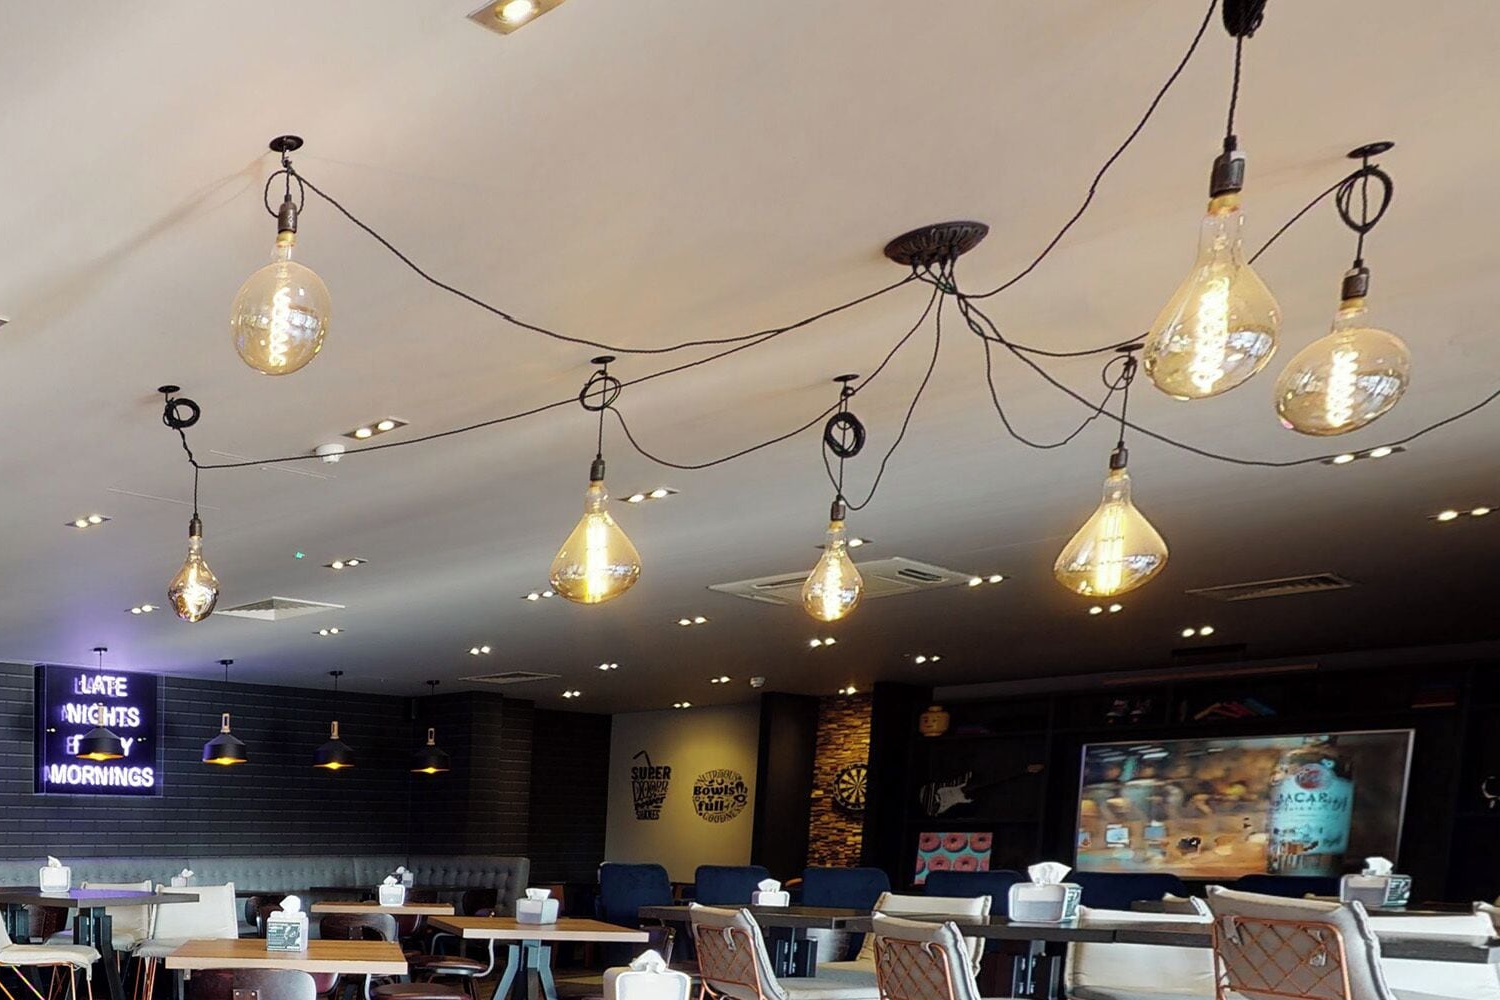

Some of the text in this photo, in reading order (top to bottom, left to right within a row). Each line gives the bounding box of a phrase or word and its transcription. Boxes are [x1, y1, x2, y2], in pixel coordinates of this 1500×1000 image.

[81, 674, 128, 697] LATE
[50, 763, 155, 787] MORNINGS
[631, 766, 671, 780] SUPER
[694, 785, 735, 795] Bowls
[698, 800, 724, 811] full
